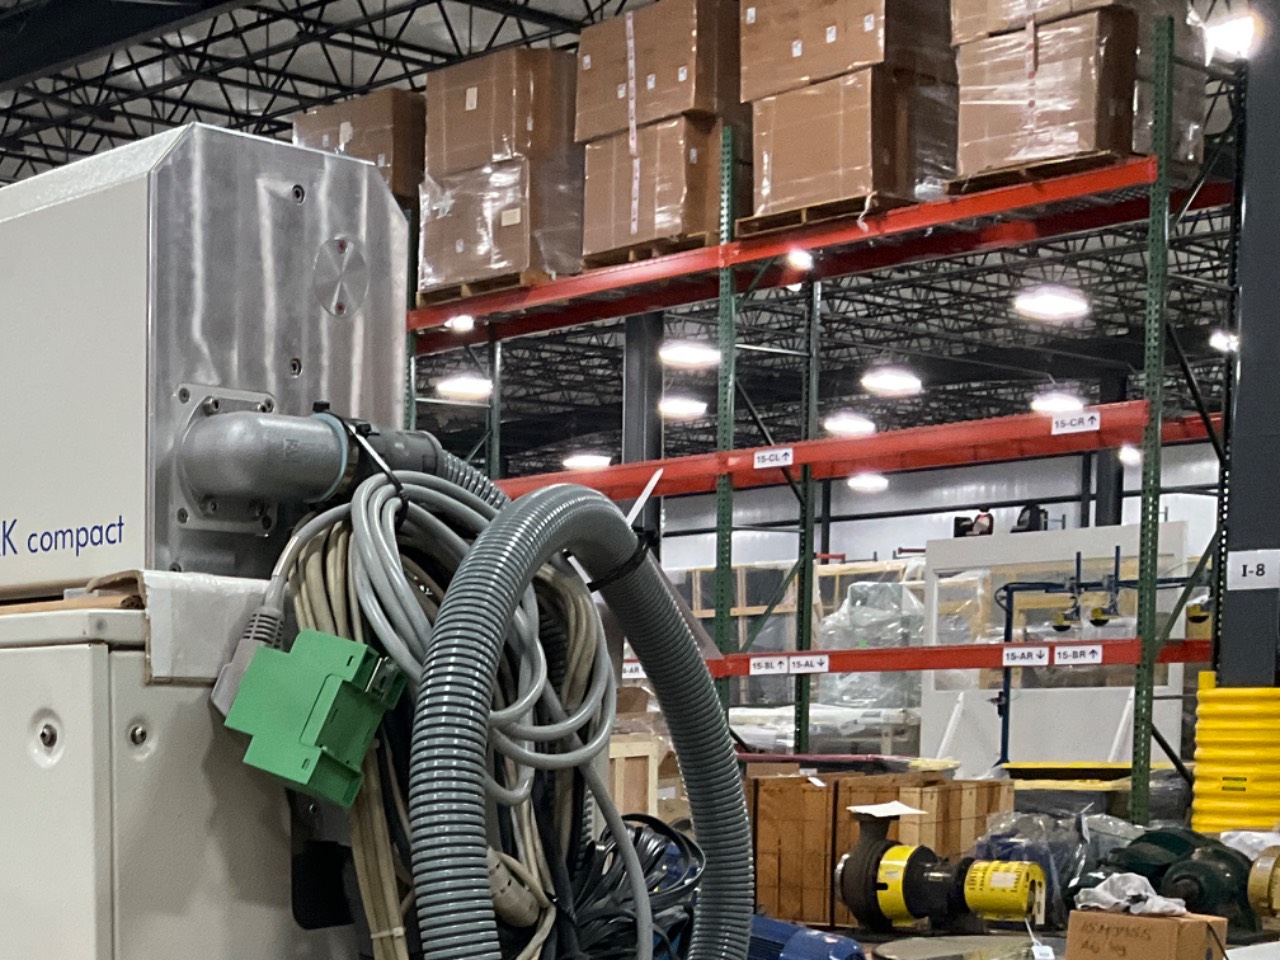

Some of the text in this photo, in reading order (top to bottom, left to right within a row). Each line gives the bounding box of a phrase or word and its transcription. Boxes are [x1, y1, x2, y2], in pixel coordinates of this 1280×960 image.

[1055, 417, 1085, 428] 15-CR
[757, 454, 780, 463] 15-CL
[26, 514, 125, 558] compact
[1241, 562, 1266, 578] I-8
[1006, 652, 1033, 661] 15-AR
[1057, 651, 1086, 660] 15-BR
[752, 661, 775, 670] 15-BL
[792, 660, 814, 669] 15-AL
